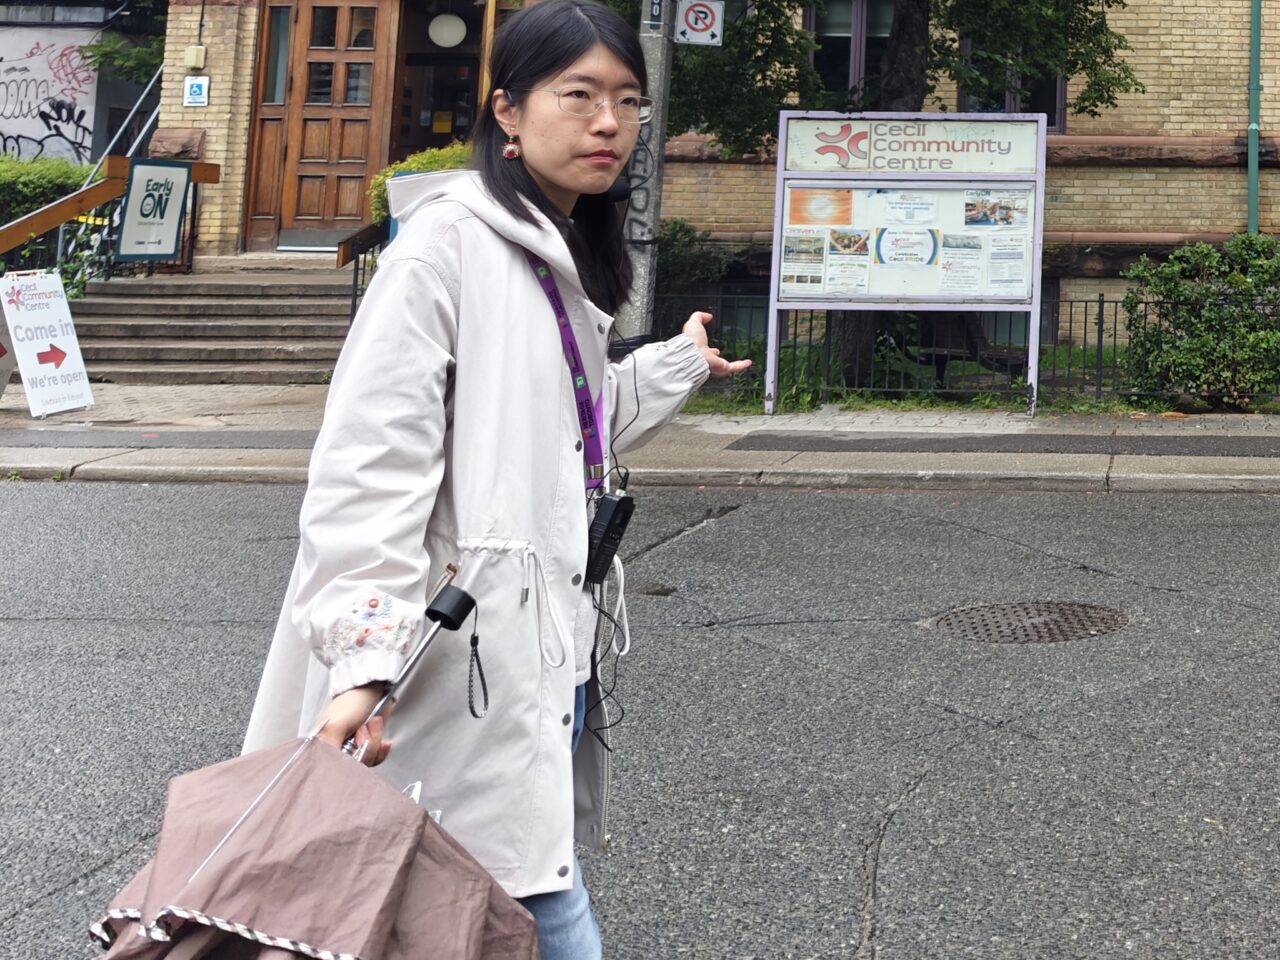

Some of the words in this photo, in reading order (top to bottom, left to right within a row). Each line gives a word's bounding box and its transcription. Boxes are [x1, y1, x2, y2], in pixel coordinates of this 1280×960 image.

[873, 123, 926, 137] Cecil
[873, 138, 1012, 155] Community
[872, 155, 954, 170] Centre
[145, 178, 174, 197] Early
[140, 192, 169, 220] ON
[23, 290, 64, 302] Community
[25, 302, 50, 311] Centre
[13, 324, 58, 343] Come
[58, 319, 75, 337] in
[27, 374, 59, 389] We're
[60, 371, 85, 386] open
